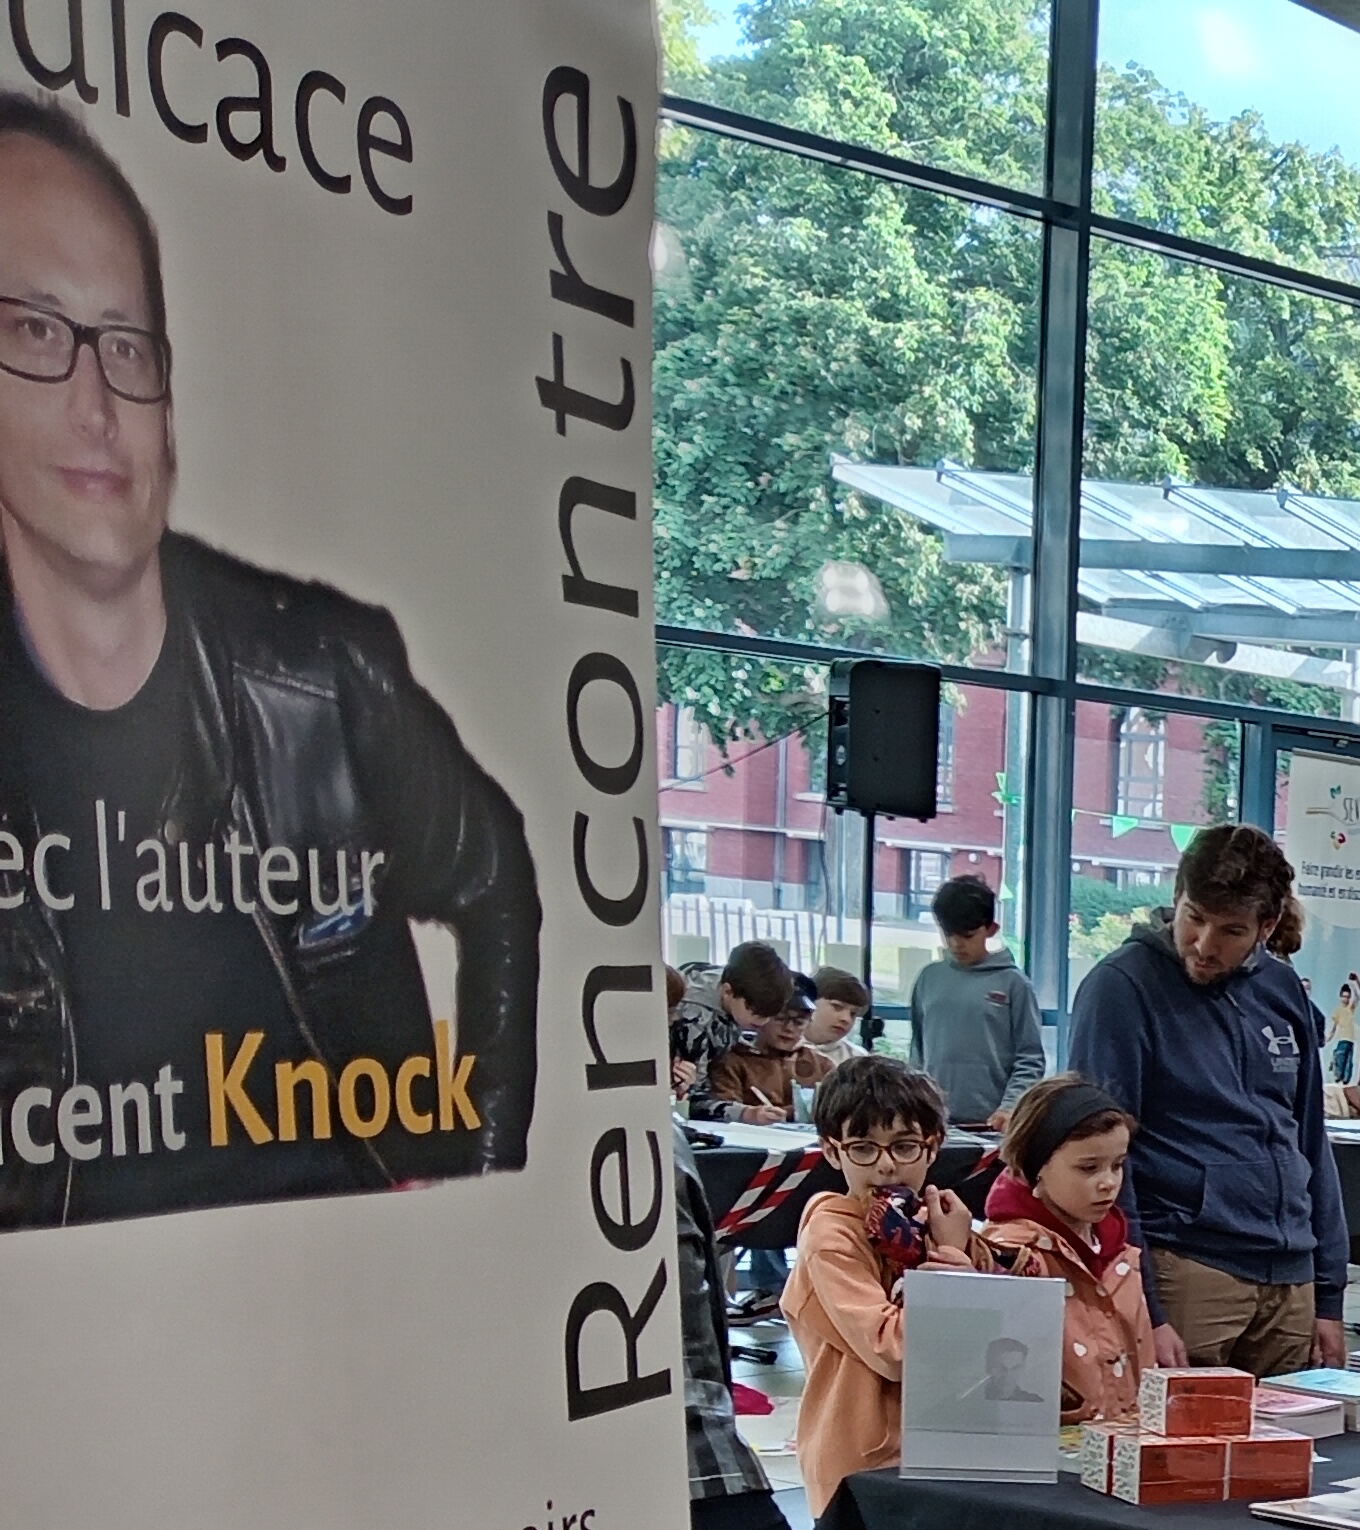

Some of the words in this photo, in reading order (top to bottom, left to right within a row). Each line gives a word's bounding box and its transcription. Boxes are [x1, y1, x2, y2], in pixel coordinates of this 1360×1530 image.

[535, 65, 672, 1422] Rencontre
[0, 830, 75, 912] ec
[94, 799, 385, 918] l'auteur
[0, 1063, 188, 1166] cent
[204, 1019, 482, 1148] Knock
